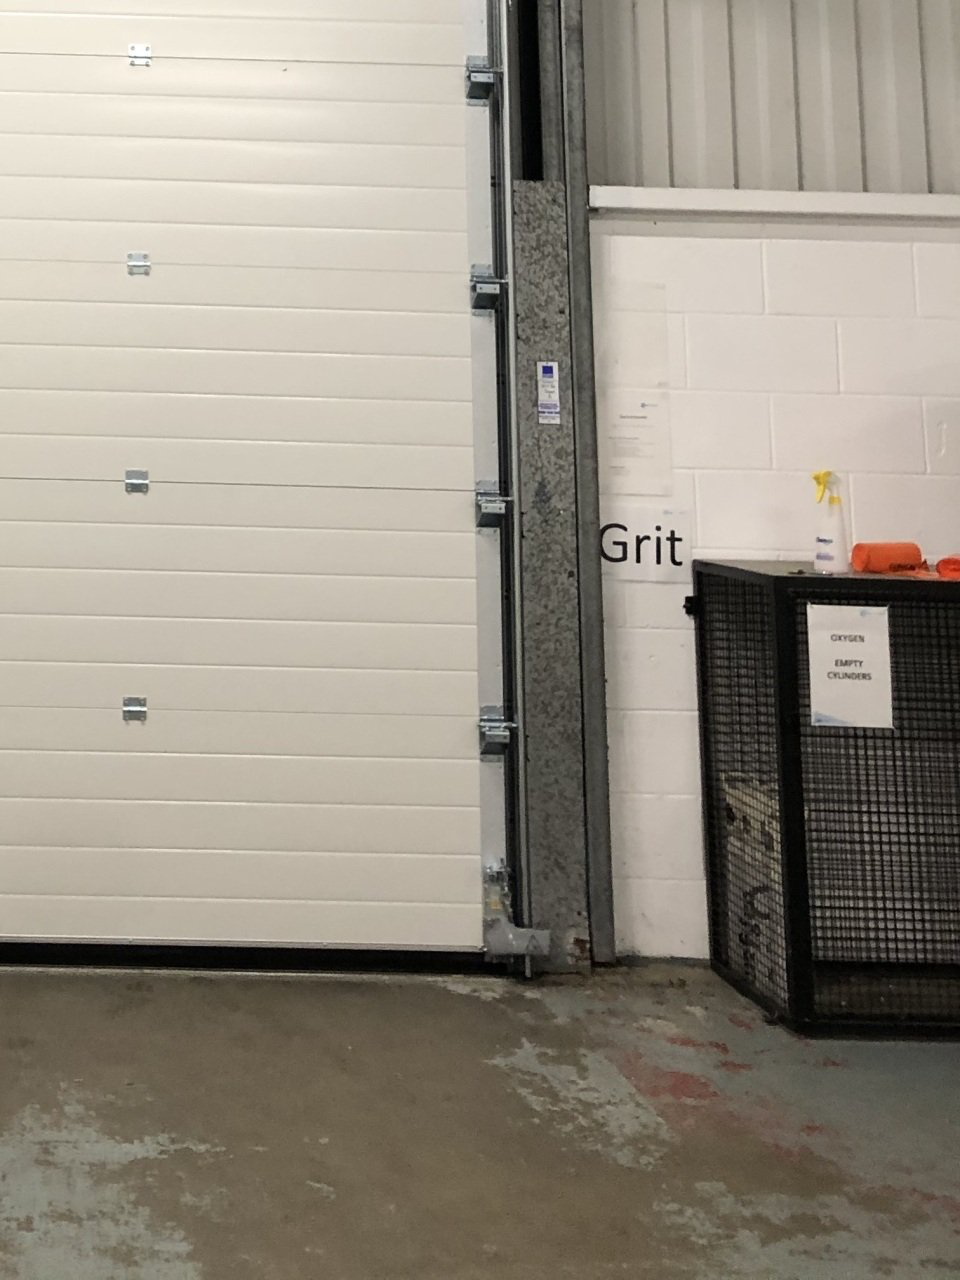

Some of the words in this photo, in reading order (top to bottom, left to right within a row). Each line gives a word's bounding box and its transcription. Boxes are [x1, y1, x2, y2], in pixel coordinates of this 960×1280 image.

[599, 523, 683, 567] Grit
[830, 633, 865, 643] OXYGEN
[835, 659, 864, 668] EMPTY
[827, 671, 872, 681] CYLINDERS
